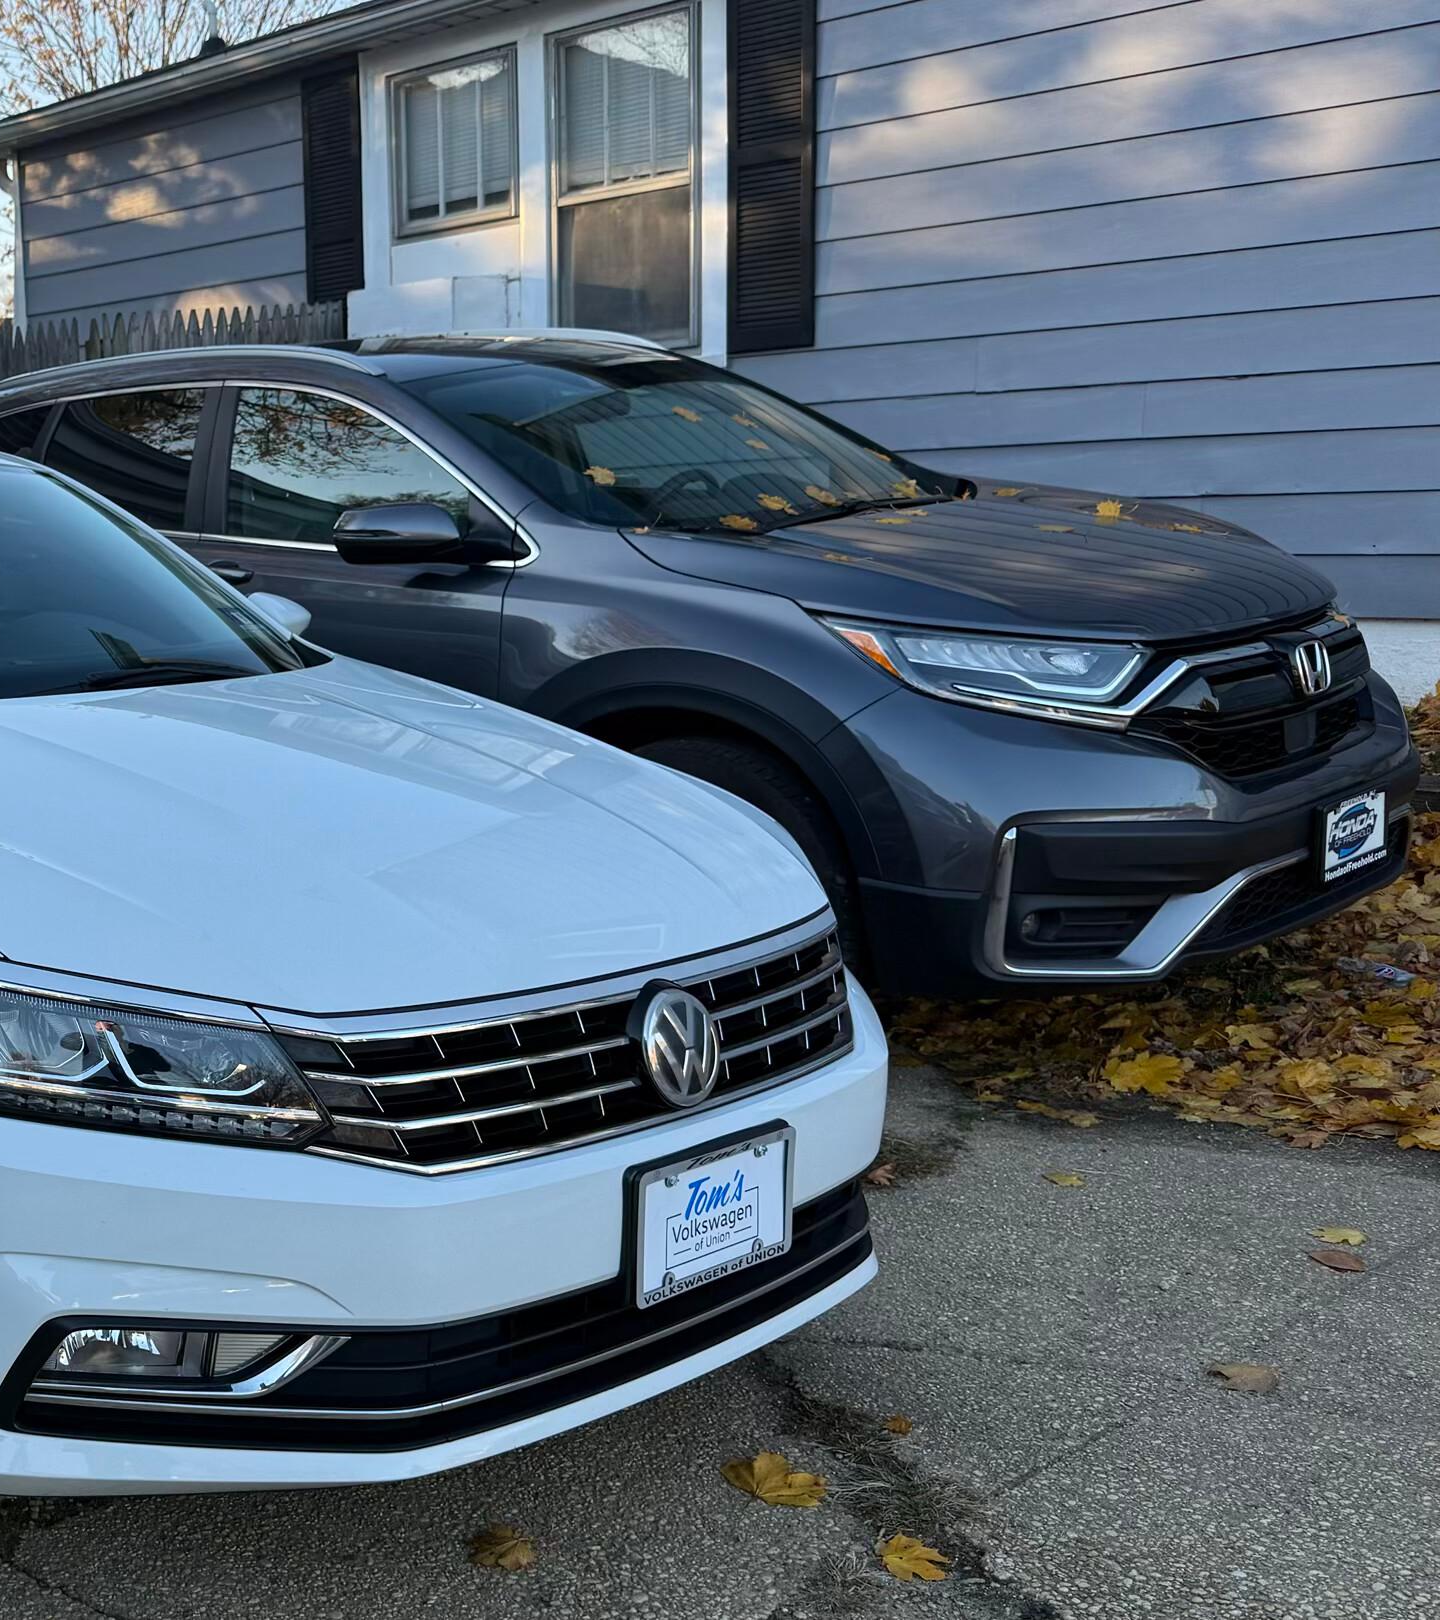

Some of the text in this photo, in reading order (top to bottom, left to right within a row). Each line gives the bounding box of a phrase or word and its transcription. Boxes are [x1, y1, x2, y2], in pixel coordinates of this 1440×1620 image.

[1329, 811, 1375, 842] HONDA
[1334, 827, 1372, 848] OF FREEHOLD
[685, 1169, 744, 1220] Tom's
[672, 1204, 752, 1243] Volkswagen
[694, 1231, 731, 1252] of Union
[644, 1244, 785, 1305] VOLKSWAGEN of UNION
